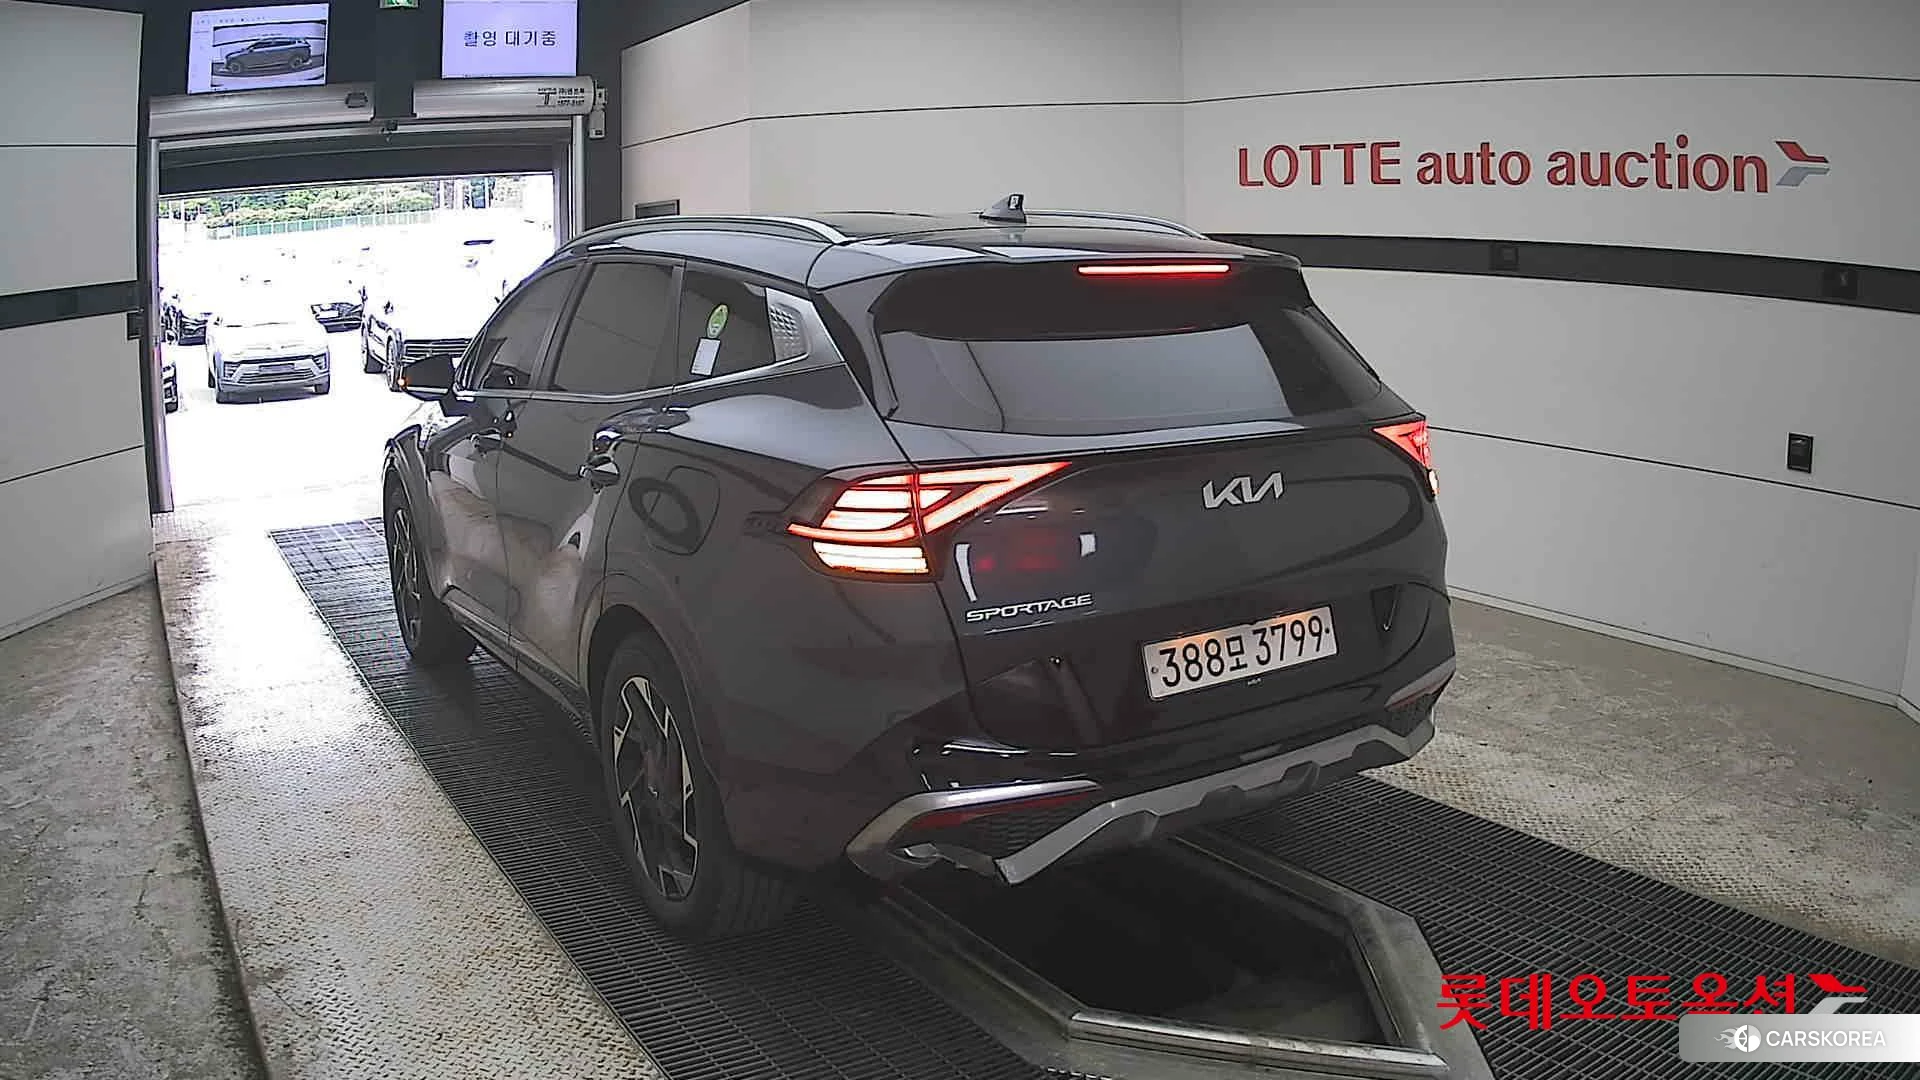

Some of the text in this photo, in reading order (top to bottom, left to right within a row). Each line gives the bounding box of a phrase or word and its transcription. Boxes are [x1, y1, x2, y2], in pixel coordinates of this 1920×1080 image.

[505, 30, 556, 47] 대기중
[1238, 134, 1768, 193] LOTTE auto auction
[1203, 472, 1283, 508] KIA
[966, 594, 1093, 622] SPORTAGE
